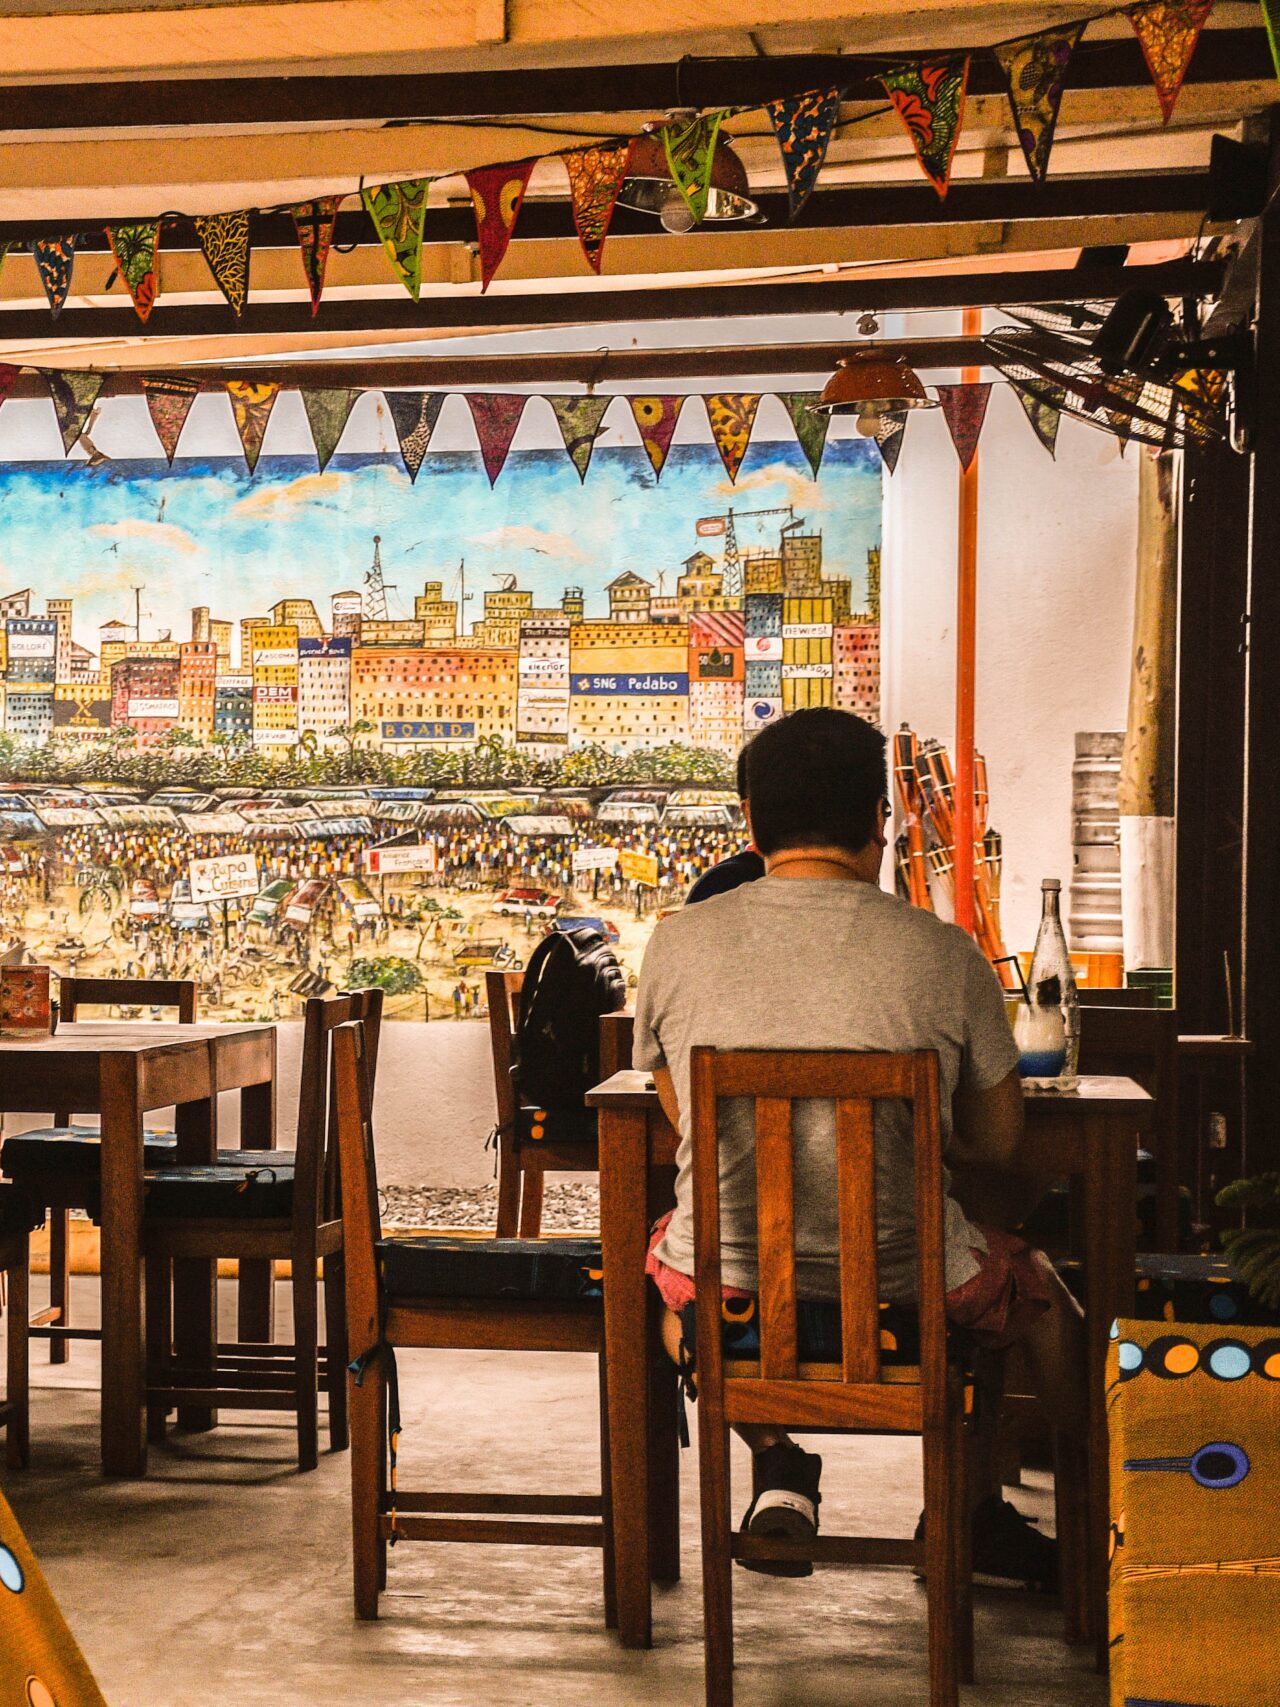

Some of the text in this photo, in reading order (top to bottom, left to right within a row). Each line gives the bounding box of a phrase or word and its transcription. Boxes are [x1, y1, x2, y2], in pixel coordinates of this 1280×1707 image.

[593, 675, 678, 690] SNG Pedabo
[256, 687, 292, 698] DEM
[211, 861, 247, 880] Papa
[211, 876, 257, 892] Cuisine
